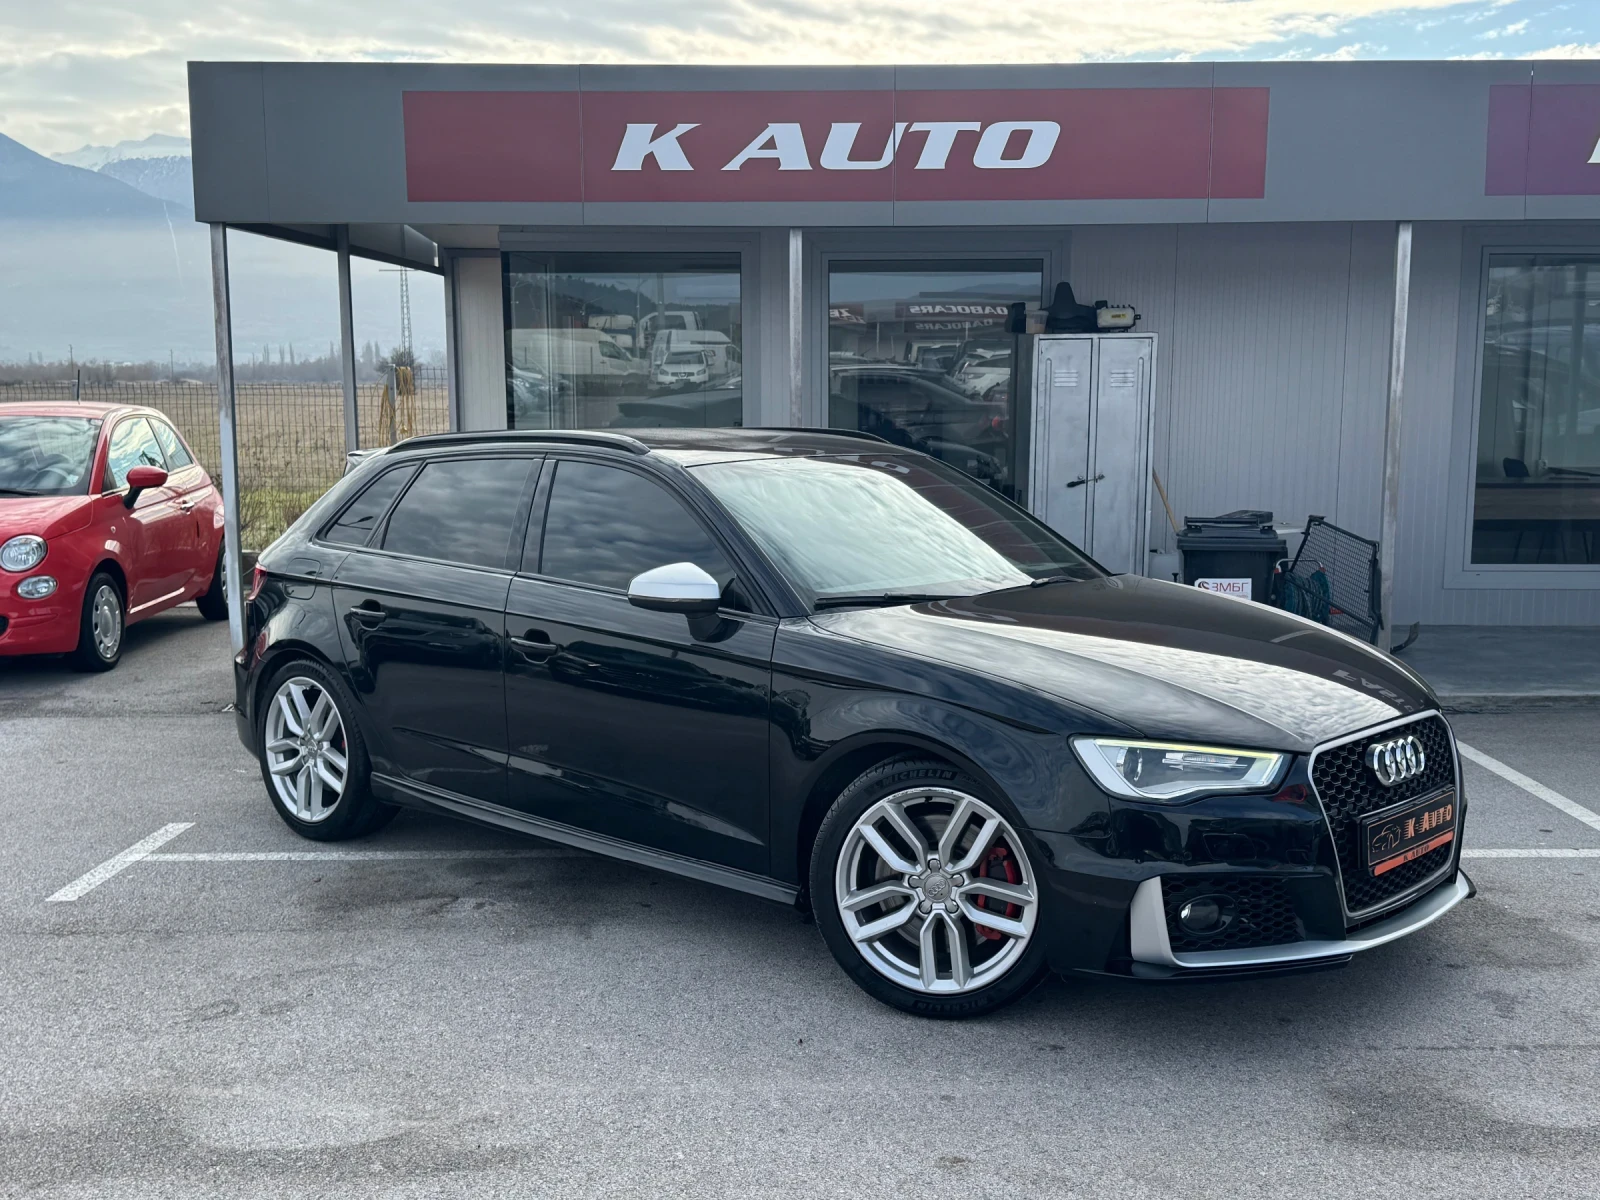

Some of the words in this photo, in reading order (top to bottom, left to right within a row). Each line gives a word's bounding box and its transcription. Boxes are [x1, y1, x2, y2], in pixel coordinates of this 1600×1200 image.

[610, 123, 702, 171] K
[720, 120, 1061, 171] AUTO
[882, 769, 953, 786] MICHELIN
